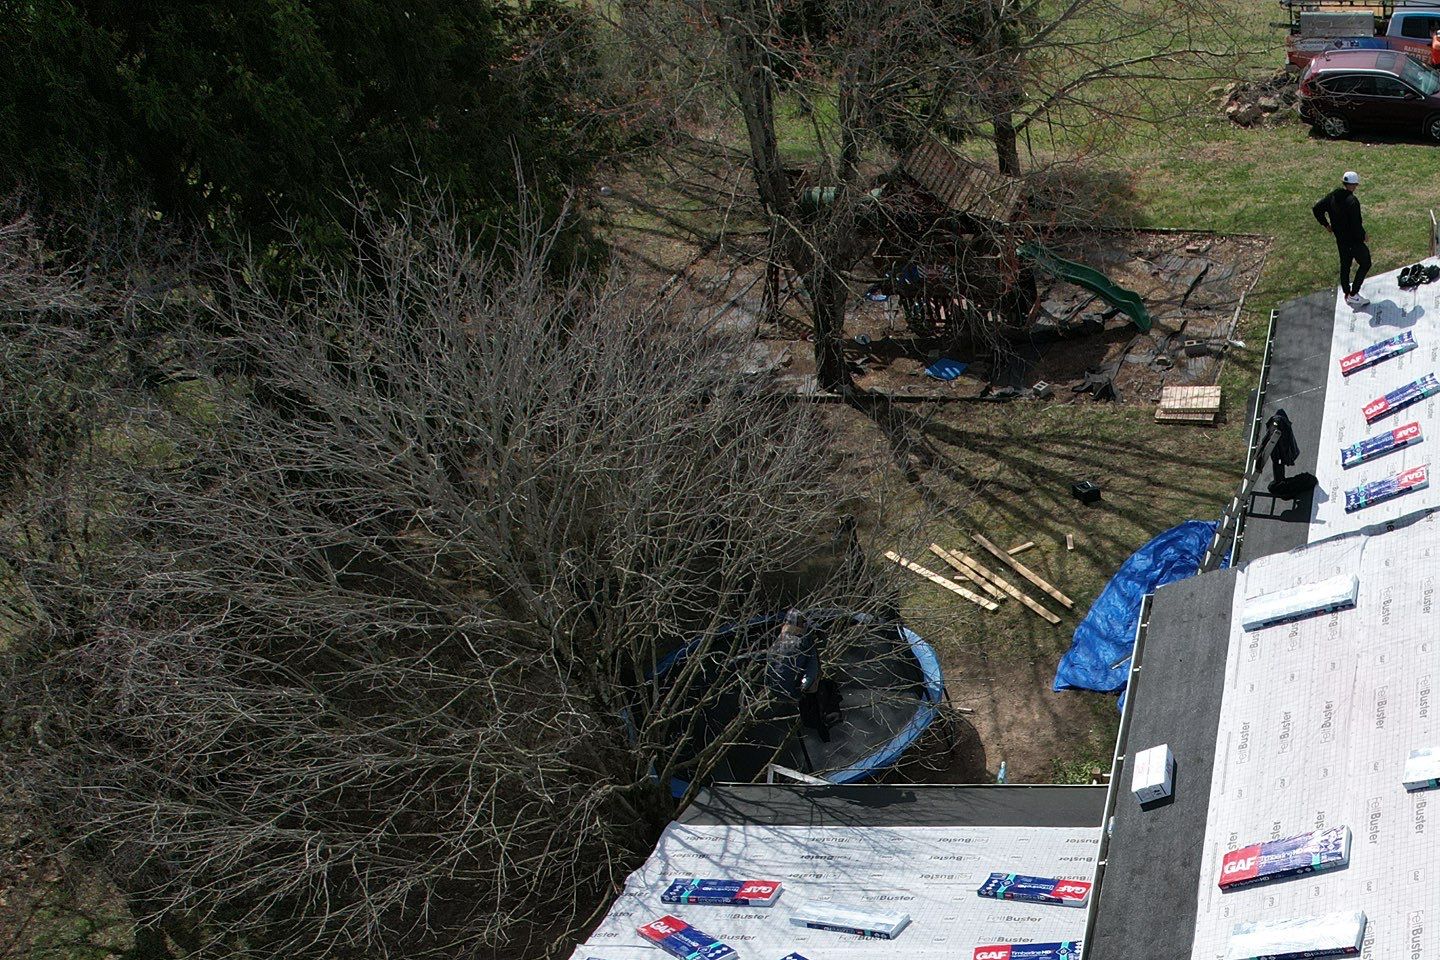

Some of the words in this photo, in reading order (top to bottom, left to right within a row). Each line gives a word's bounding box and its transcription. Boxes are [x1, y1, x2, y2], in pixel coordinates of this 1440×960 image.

[1224, 858, 1257, 875] GAF
[650, 921, 676, 935] GAF
[976, 952, 1008, 960] GAF
